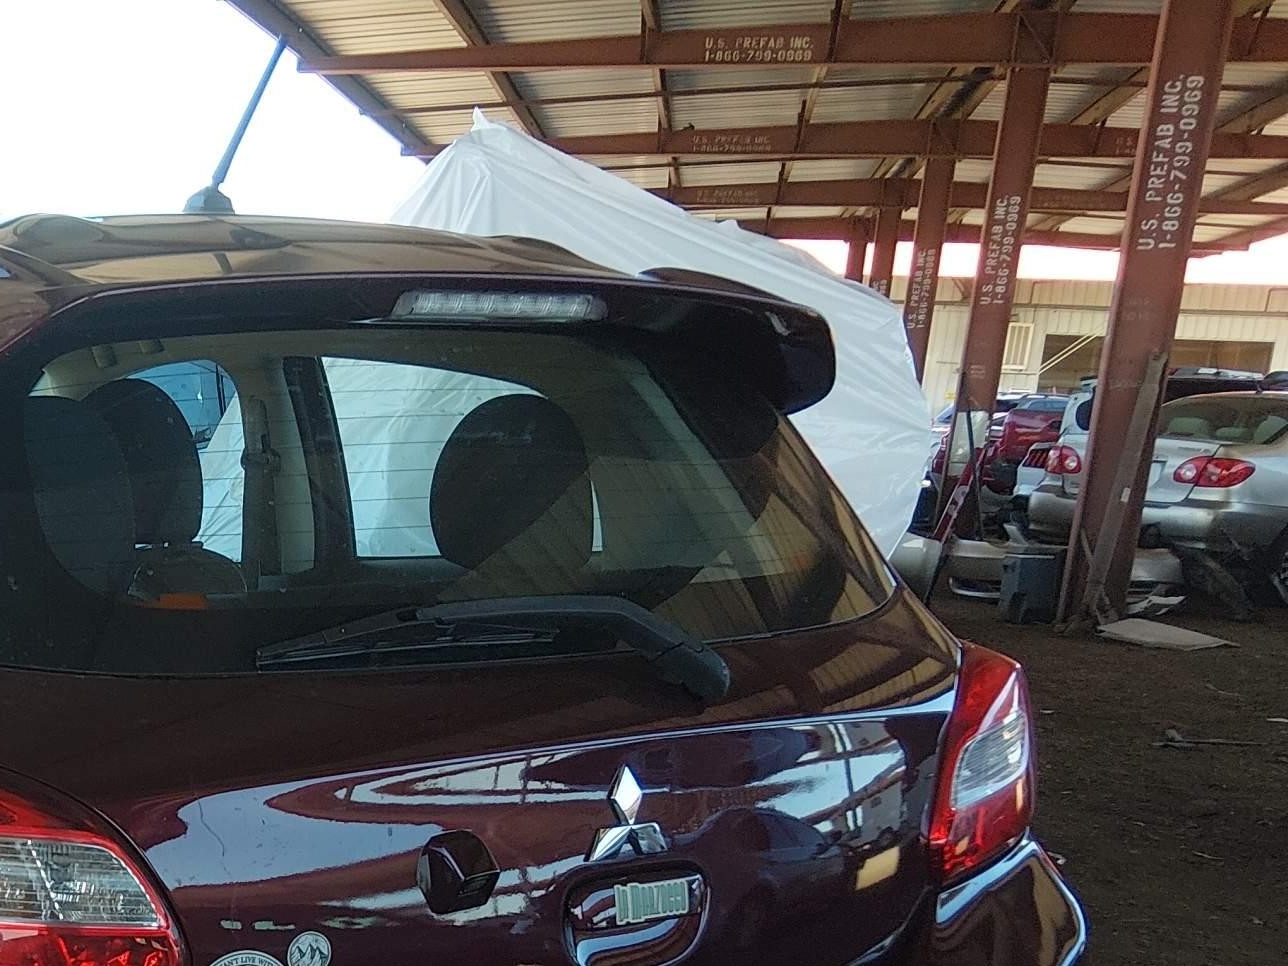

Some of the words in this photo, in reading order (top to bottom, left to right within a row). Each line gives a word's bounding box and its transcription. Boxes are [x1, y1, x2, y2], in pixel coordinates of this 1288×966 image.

[1160, 74, 1186, 113] INC.
[1145, 123, 1175, 202] PREFAB
[1158, 75, 1206, 249] 1-866-799-0969
[984, 225, 1004, 275] PREFAB
[1137, 213, 1160, 250] U.S.
[240, 955, 257, 964] LIVE
